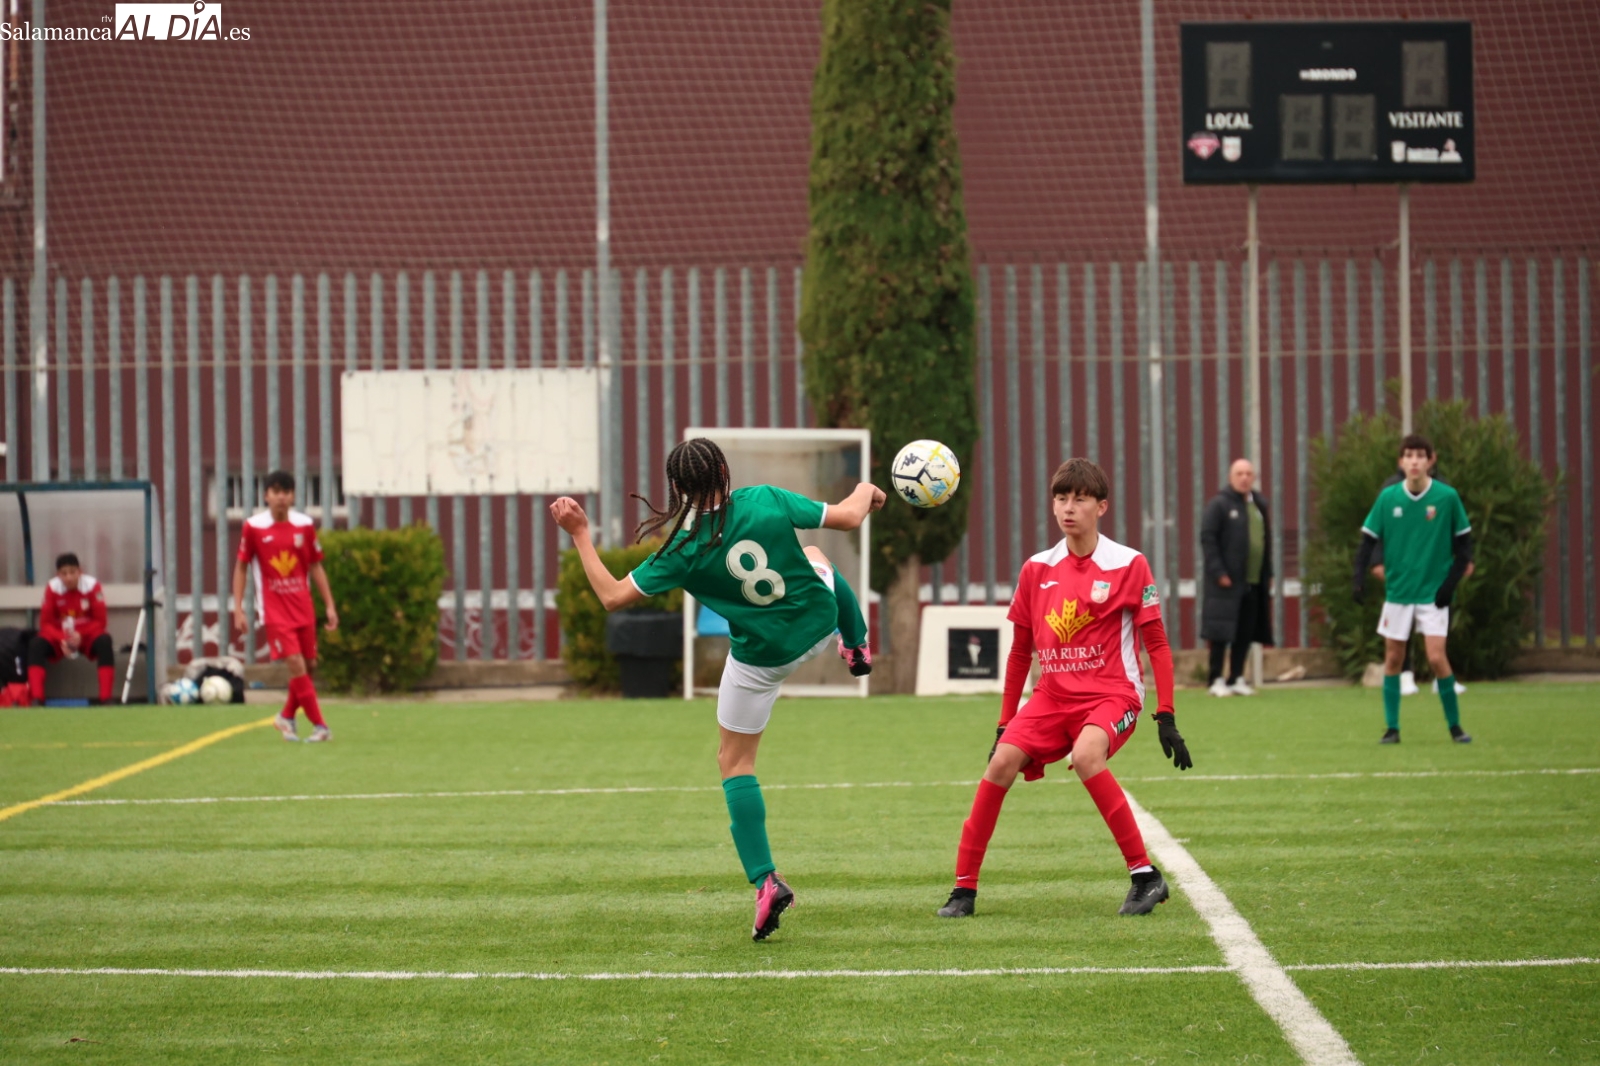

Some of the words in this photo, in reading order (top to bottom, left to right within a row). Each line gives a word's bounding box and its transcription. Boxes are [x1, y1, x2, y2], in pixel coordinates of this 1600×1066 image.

[1206, 112, 1252, 129] LOCAL
[1389, 111, 1463, 128] VISITANTE
[725, 539, 786, 606] 8
[1060, 644, 1105, 660] RURAL
